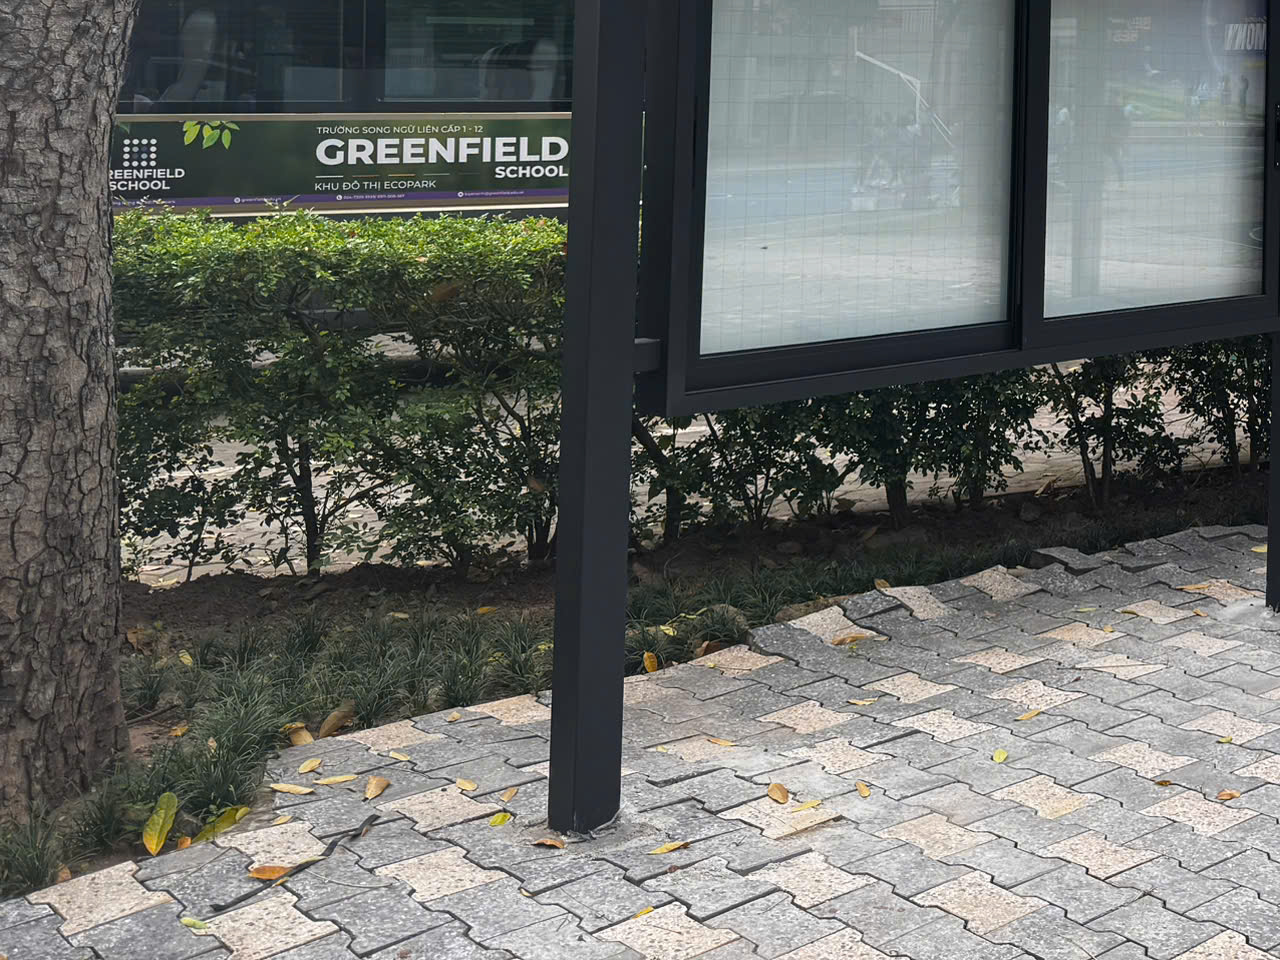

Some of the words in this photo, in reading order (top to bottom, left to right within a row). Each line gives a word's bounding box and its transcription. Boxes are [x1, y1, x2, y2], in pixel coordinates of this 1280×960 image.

[317, 124, 359, 134] TRƯỜNG
[362, 126, 390, 134] SONG
[393, 124, 416, 134] NGỮ
[417, 124, 439, 133] LIÊN
[440, 124, 460, 133] CẤP
[474, 125, 484, 133] 12
[316, 136, 569, 166] GREENFIELD
[495, 165, 569, 178] SCHOOL
[110, 180, 170, 191] SCHOOL
[314, 182, 339, 191] KHU
[342, 180, 360, 191] ĐÔ
[363, 181, 381, 191] THỊ
[384, 180, 436, 189] ECOPARK
